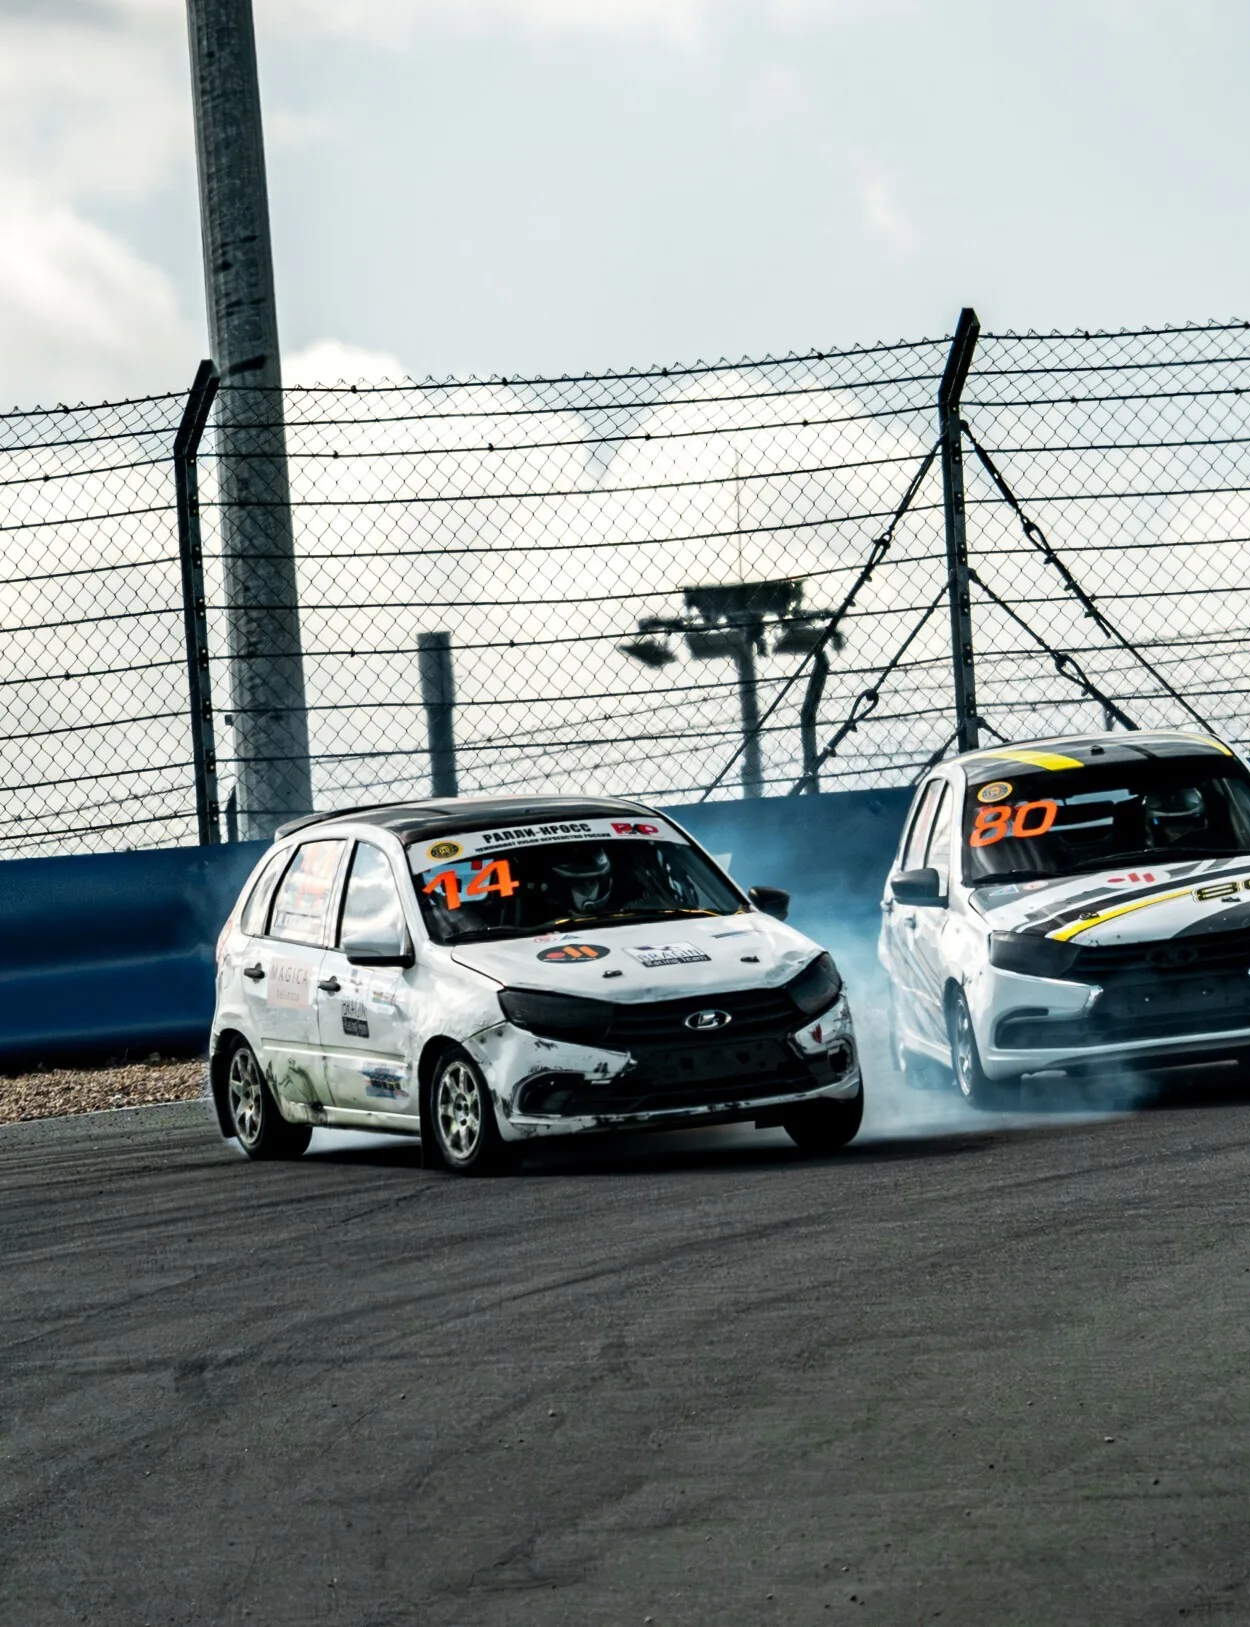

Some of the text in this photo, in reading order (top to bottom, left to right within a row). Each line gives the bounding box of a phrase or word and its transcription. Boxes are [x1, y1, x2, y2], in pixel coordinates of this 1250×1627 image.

[482, 823, 592, 844] РАЛЛИ-КРОСС
[969, 799, 1058, 848] 80
[422, 858, 520, 911] 14
[271, 963, 309, 985] MAGICA
